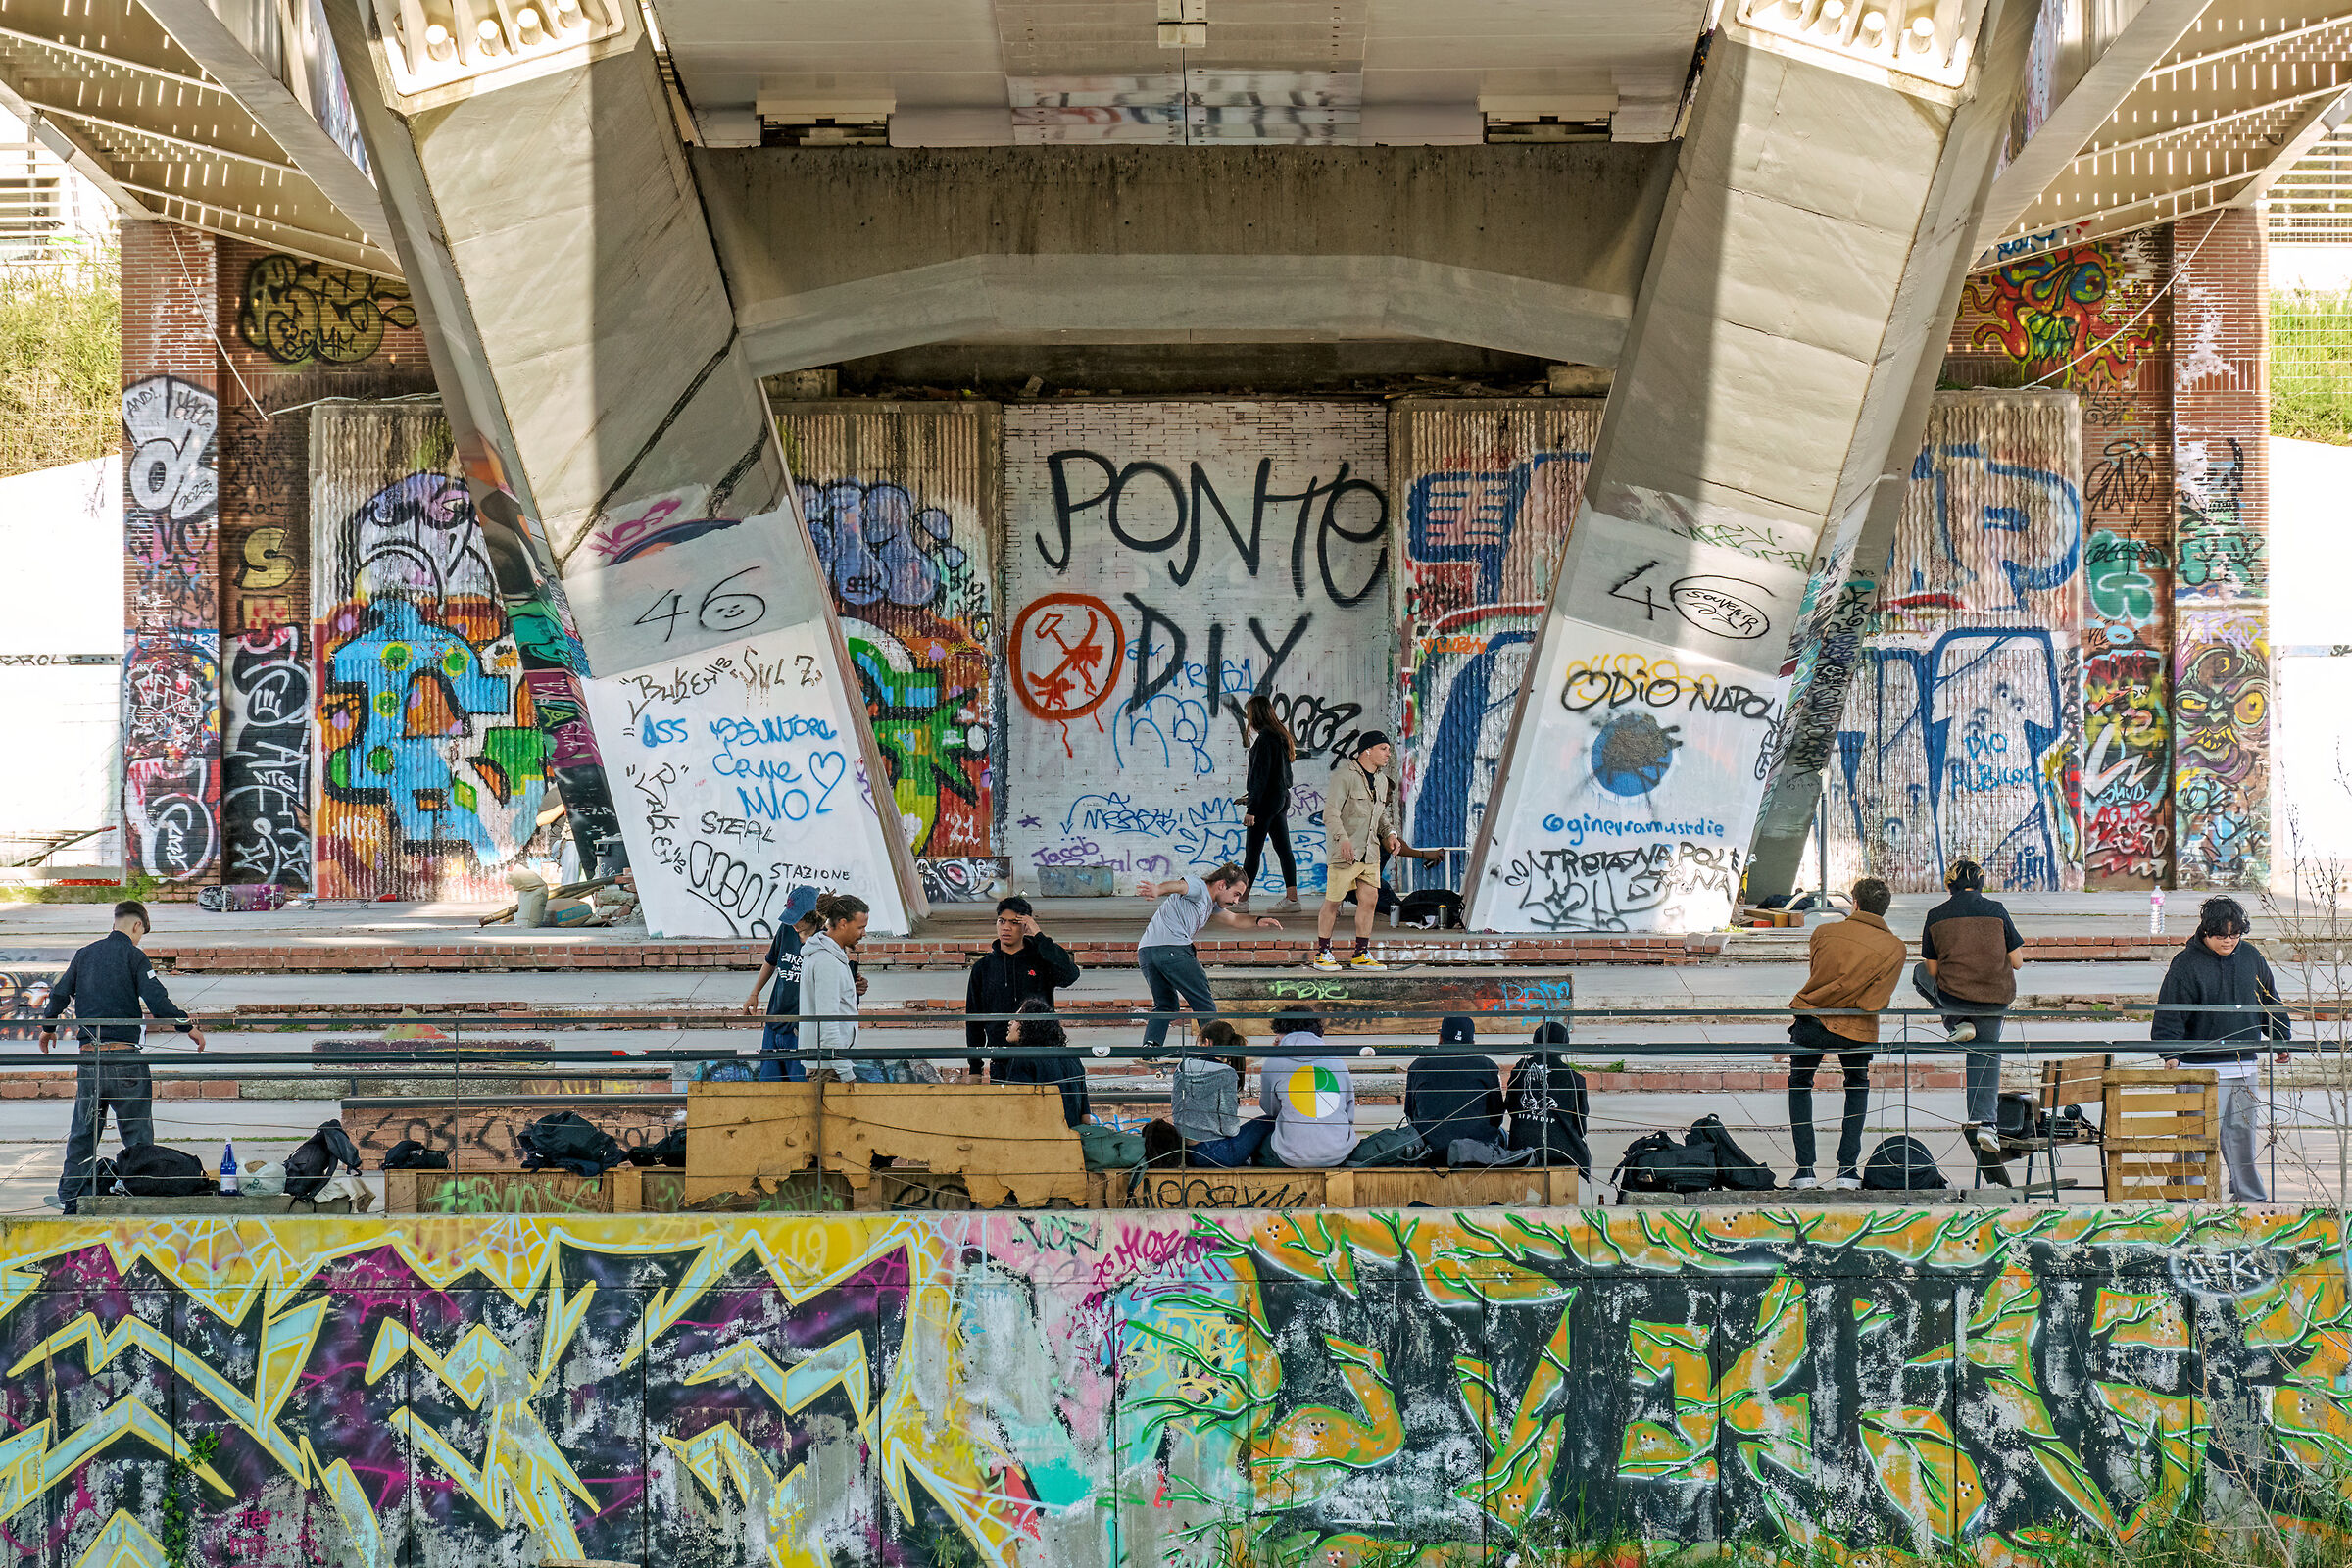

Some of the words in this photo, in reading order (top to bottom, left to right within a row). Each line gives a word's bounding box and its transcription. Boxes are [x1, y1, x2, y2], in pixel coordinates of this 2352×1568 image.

[1124, 592, 1314, 716] DIY
[700, 810, 777, 854] STEAL
[768, 862, 851, 881] STAZIONE
